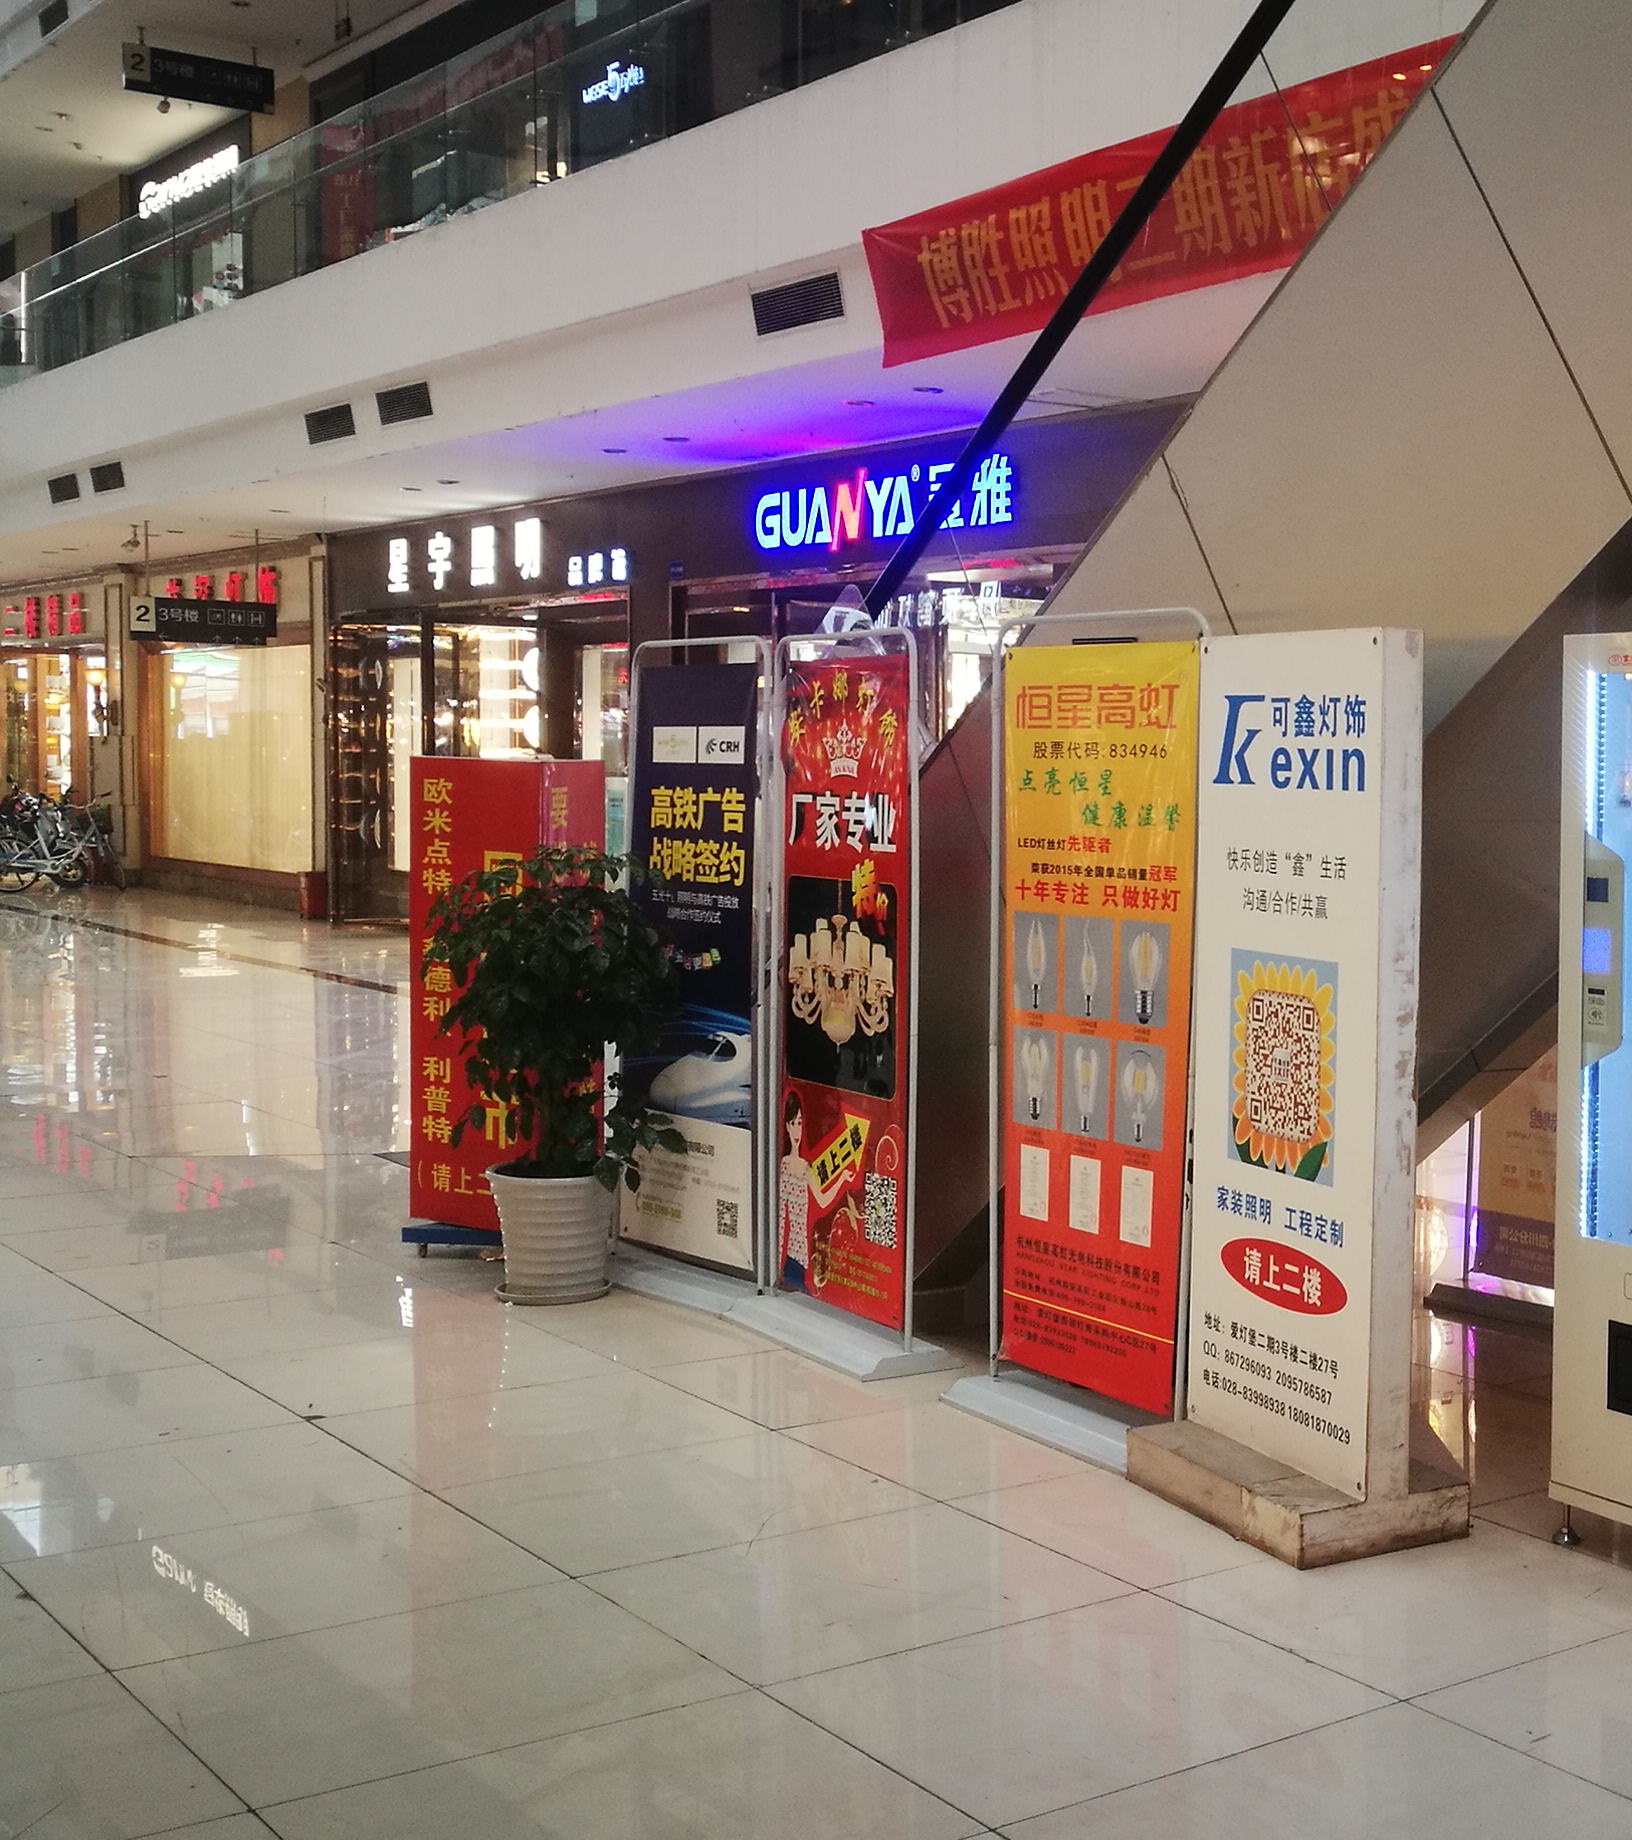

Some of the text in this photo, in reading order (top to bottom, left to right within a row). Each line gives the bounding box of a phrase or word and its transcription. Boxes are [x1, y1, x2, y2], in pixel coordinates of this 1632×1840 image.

[131, 53, 145, 72] 2
[755, 467, 915, 551] GUANYA
[136, 605, 200, 624] 2 3号楼
[1015, 682, 1181, 730] 恒星高虹
[1270, 693, 1367, 738] 可鑫灯饰
[719, 740, 740, 753] CRH
[1018, 767, 1113, 796] 点亮恒星
[650, 785, 746, 833] 高铁广告
[788, 790, 897, 853] 厂家专业
[1080, 800, 1182, 832] 健康温馨
[422, 778, 453, 897] 欧米点特
[649, 837, 745, 887] 战略签约
[1015, 878, 1181, 912] 十年专注 只做好灯
[1242, 886, 1329, 920] 沟通/合作/共赢
[422, 1055, 452, 1145] 利普特
[1216, 1186, 1344, 1249] 家装照明 工程定制
[1243, 1246, 1322, 1307] 请上二楼
[1229, 1320, 1339, 1380] 爱灯堡二期3号楼二楼27号
[1224, 1348, 1272, 1381] 867296093
[1275, 1369, 1333, 1406] 2095786587
[1287, 1405, 1351, 1445] 18081870029
